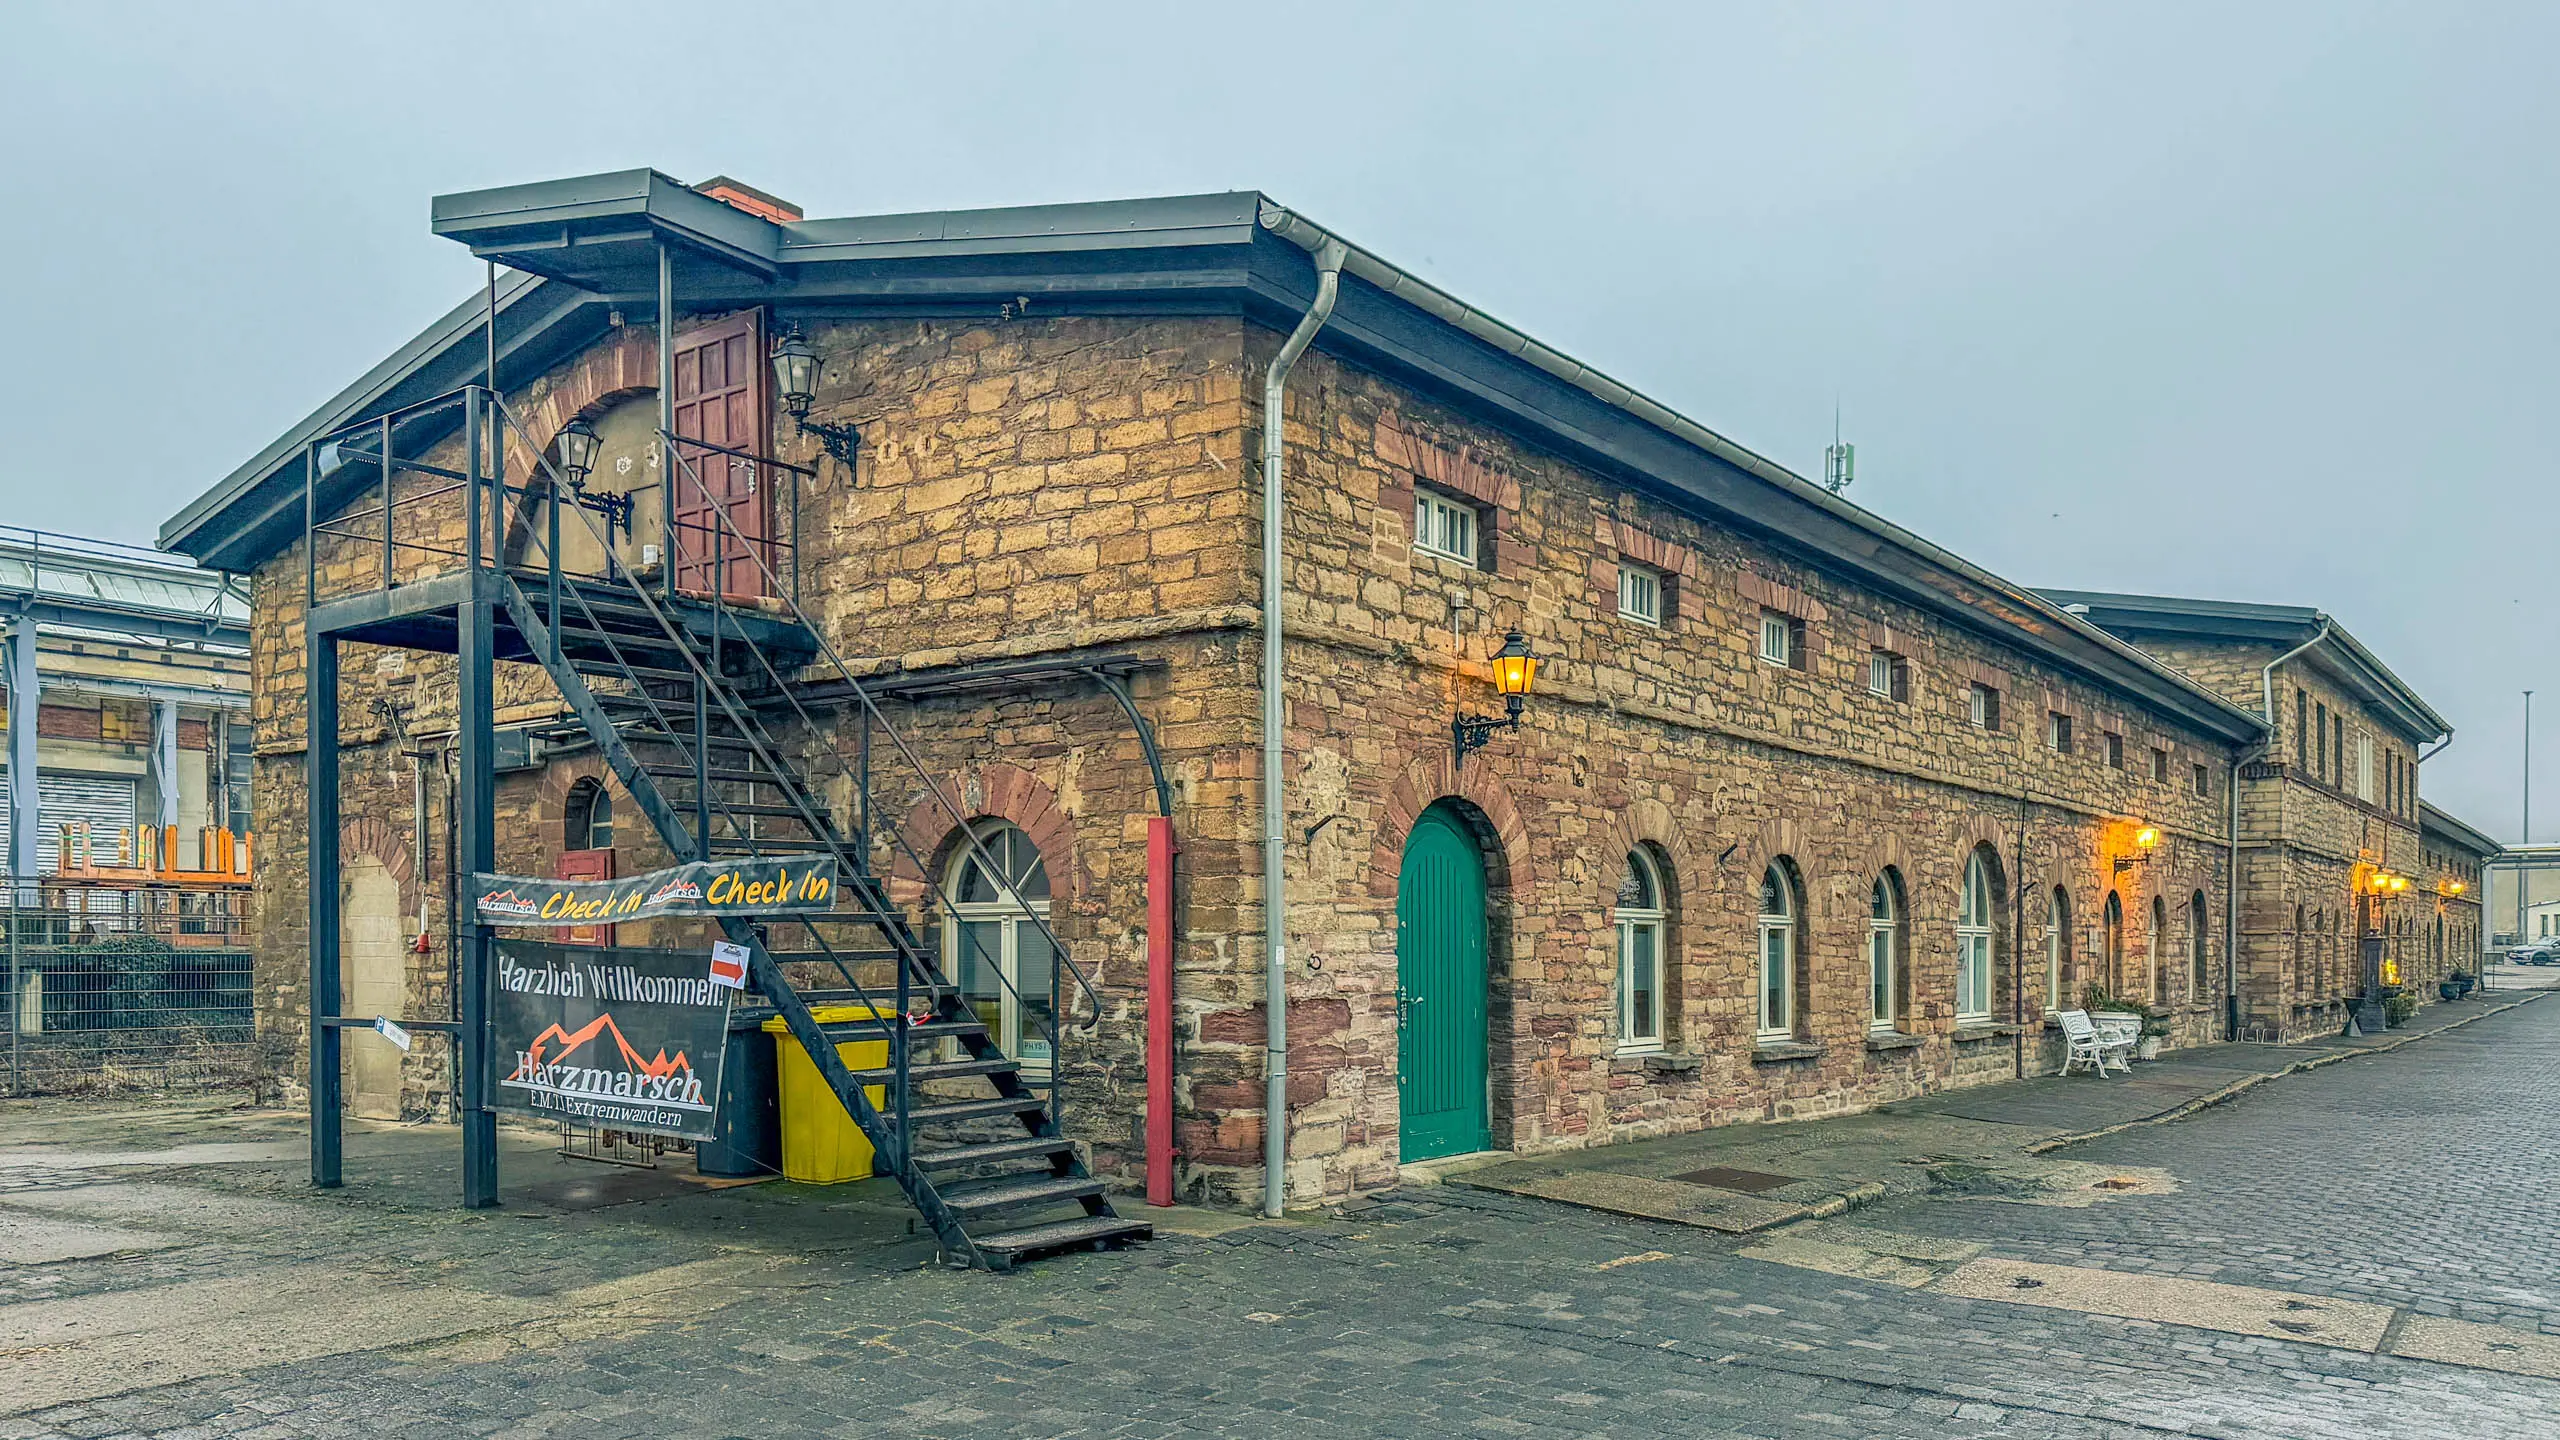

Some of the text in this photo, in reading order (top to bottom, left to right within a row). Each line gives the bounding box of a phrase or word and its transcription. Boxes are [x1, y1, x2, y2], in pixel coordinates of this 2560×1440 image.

[477, 897, 537, 913] Harzmarsch
[541, 889, 617, 919] Check
[618, 889, 644, 914] In
[706, 868, 793, 905] Check
[798, 869, 830, 901] In
[498, 955, 725, 1007] Harzlich Willkommen!
[515, 1050, 703, 1104] Harzmarsch
